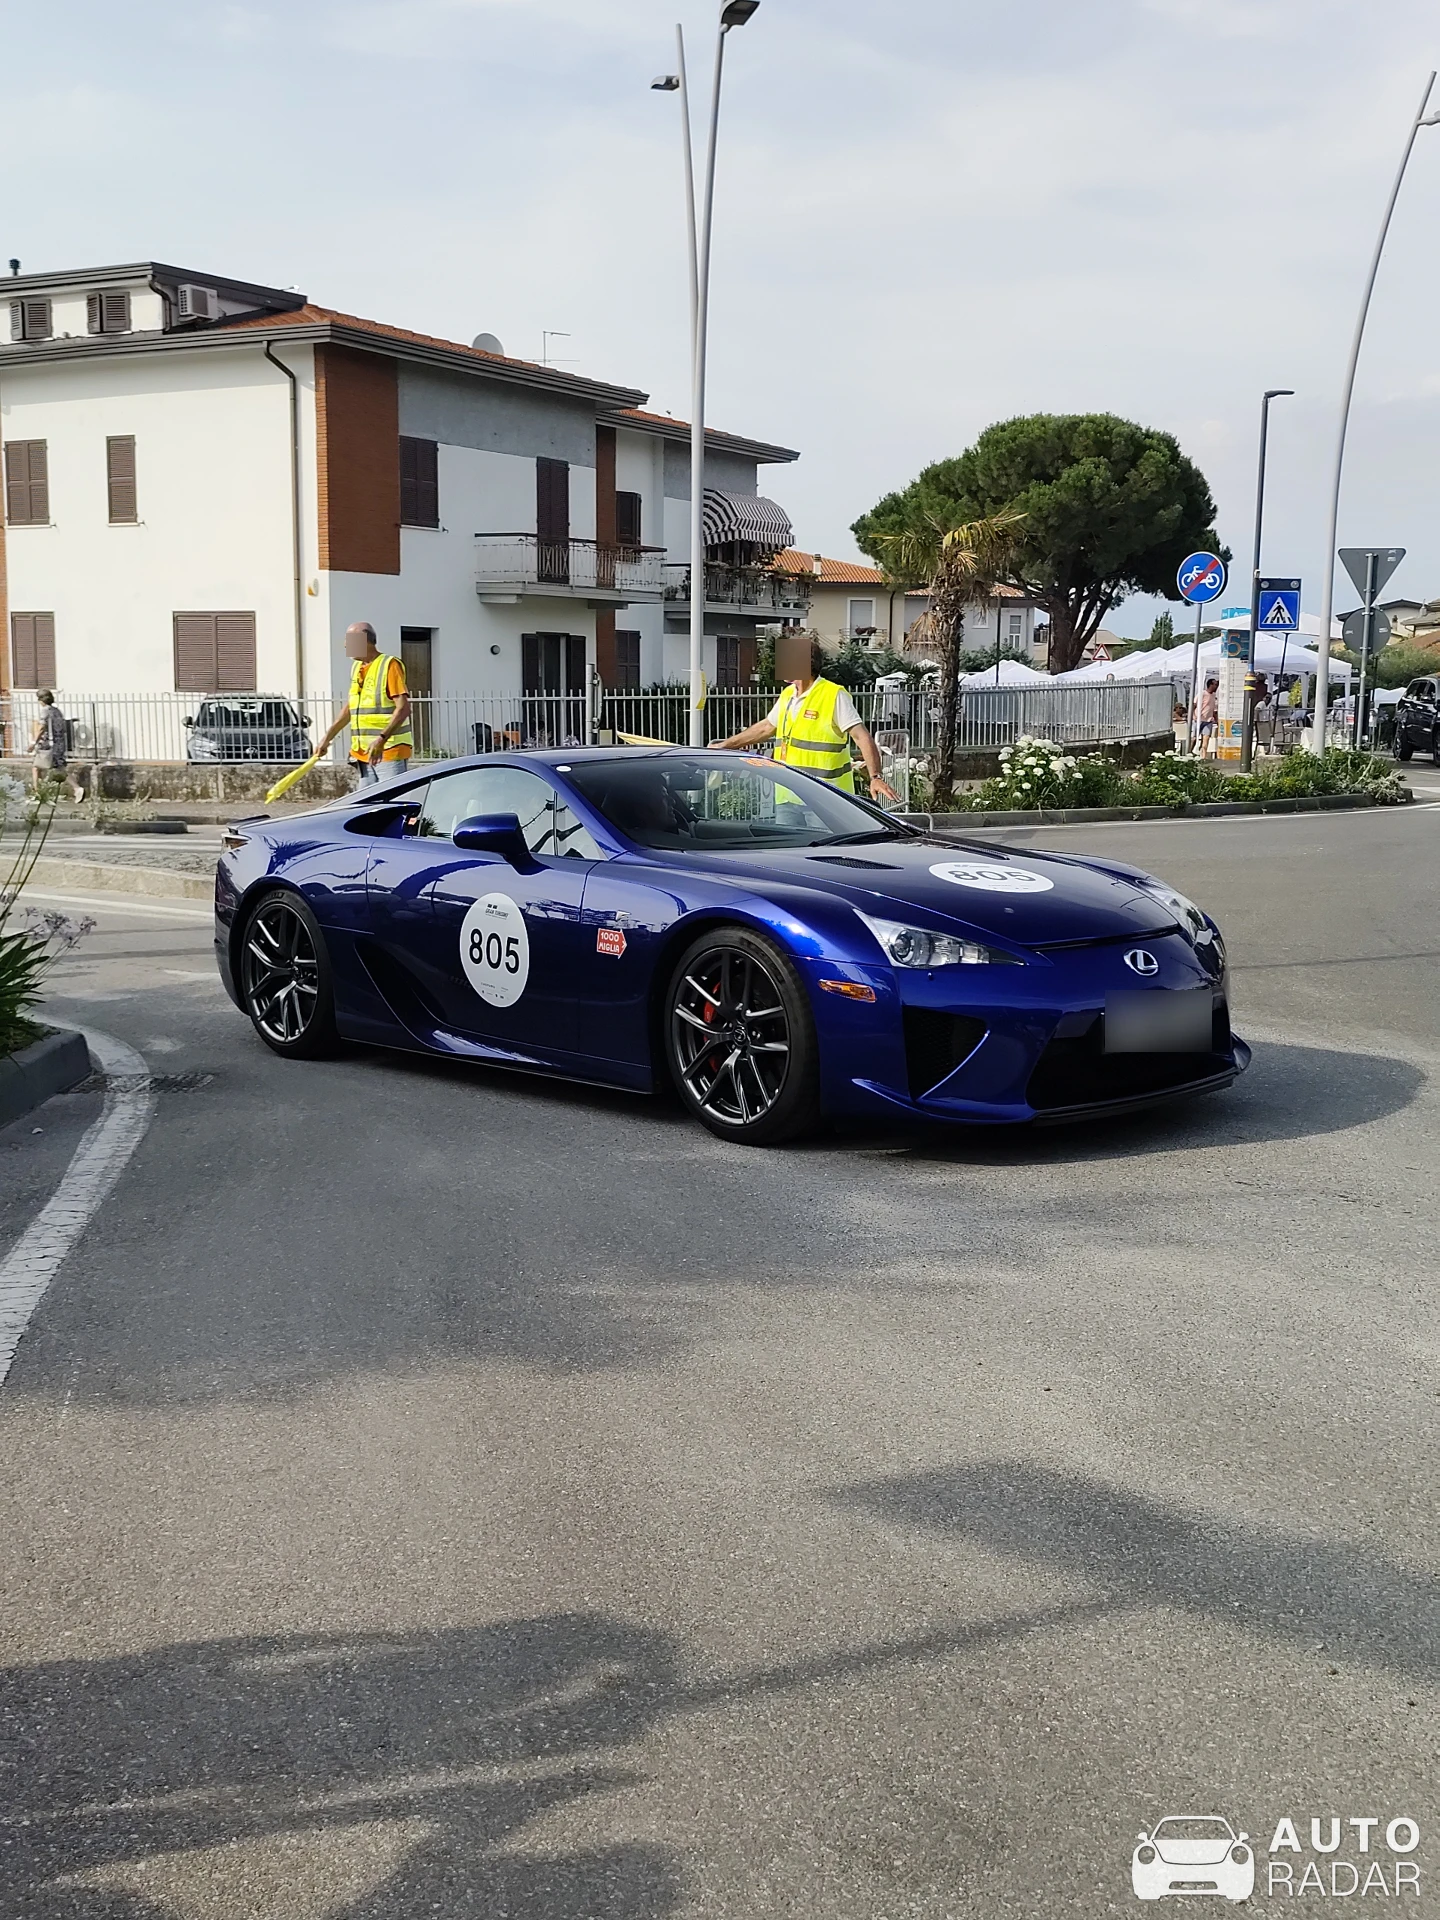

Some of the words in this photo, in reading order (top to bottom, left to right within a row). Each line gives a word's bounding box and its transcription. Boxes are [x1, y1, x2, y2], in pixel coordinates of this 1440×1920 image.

[947, 870, 1036, 882] 805
[601, 932, 620, 942] 1000
[469, 928, 520, 974] 805
[598, 942, 620, 953] MIGLIA
